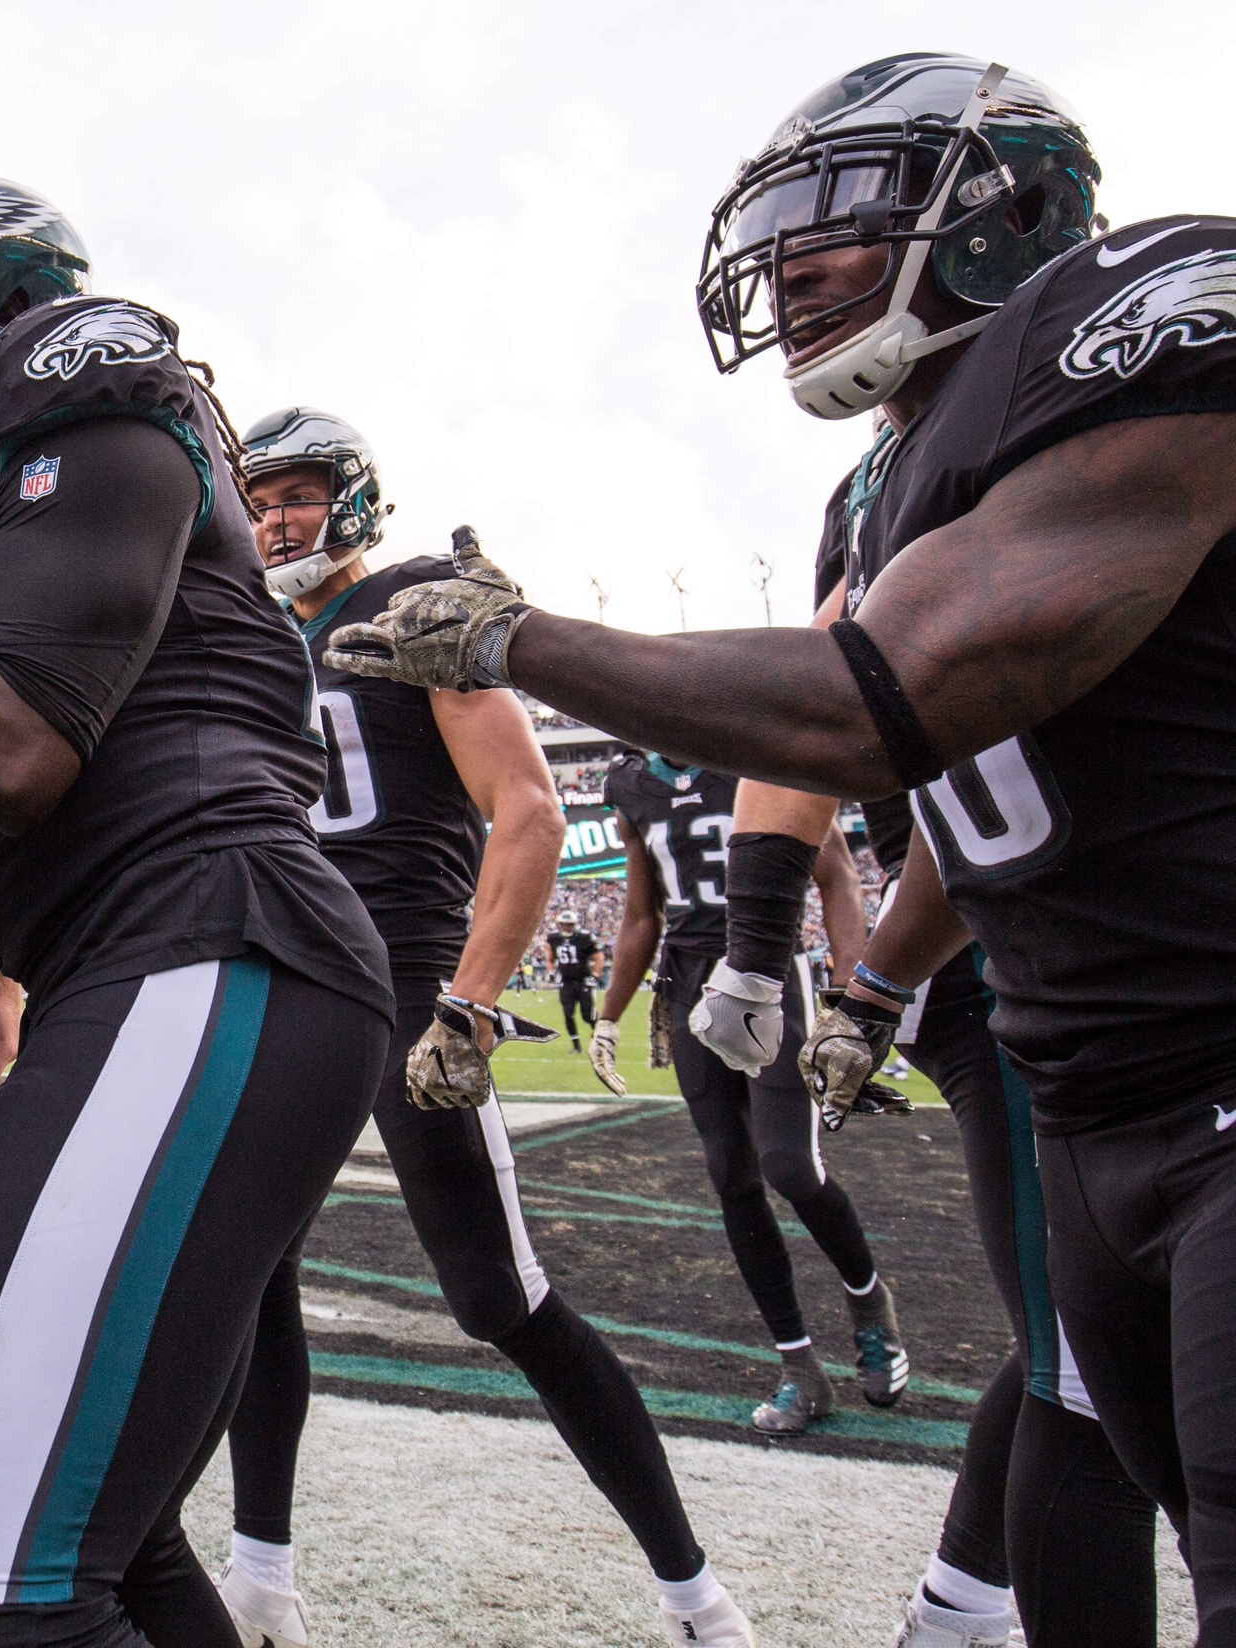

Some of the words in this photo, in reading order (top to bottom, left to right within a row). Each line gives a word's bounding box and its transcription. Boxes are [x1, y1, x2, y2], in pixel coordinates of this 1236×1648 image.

[24, 473, 52, 496] NFL
[644, 814, 734, 906] 13
[555, 944, 579, 964] 61
